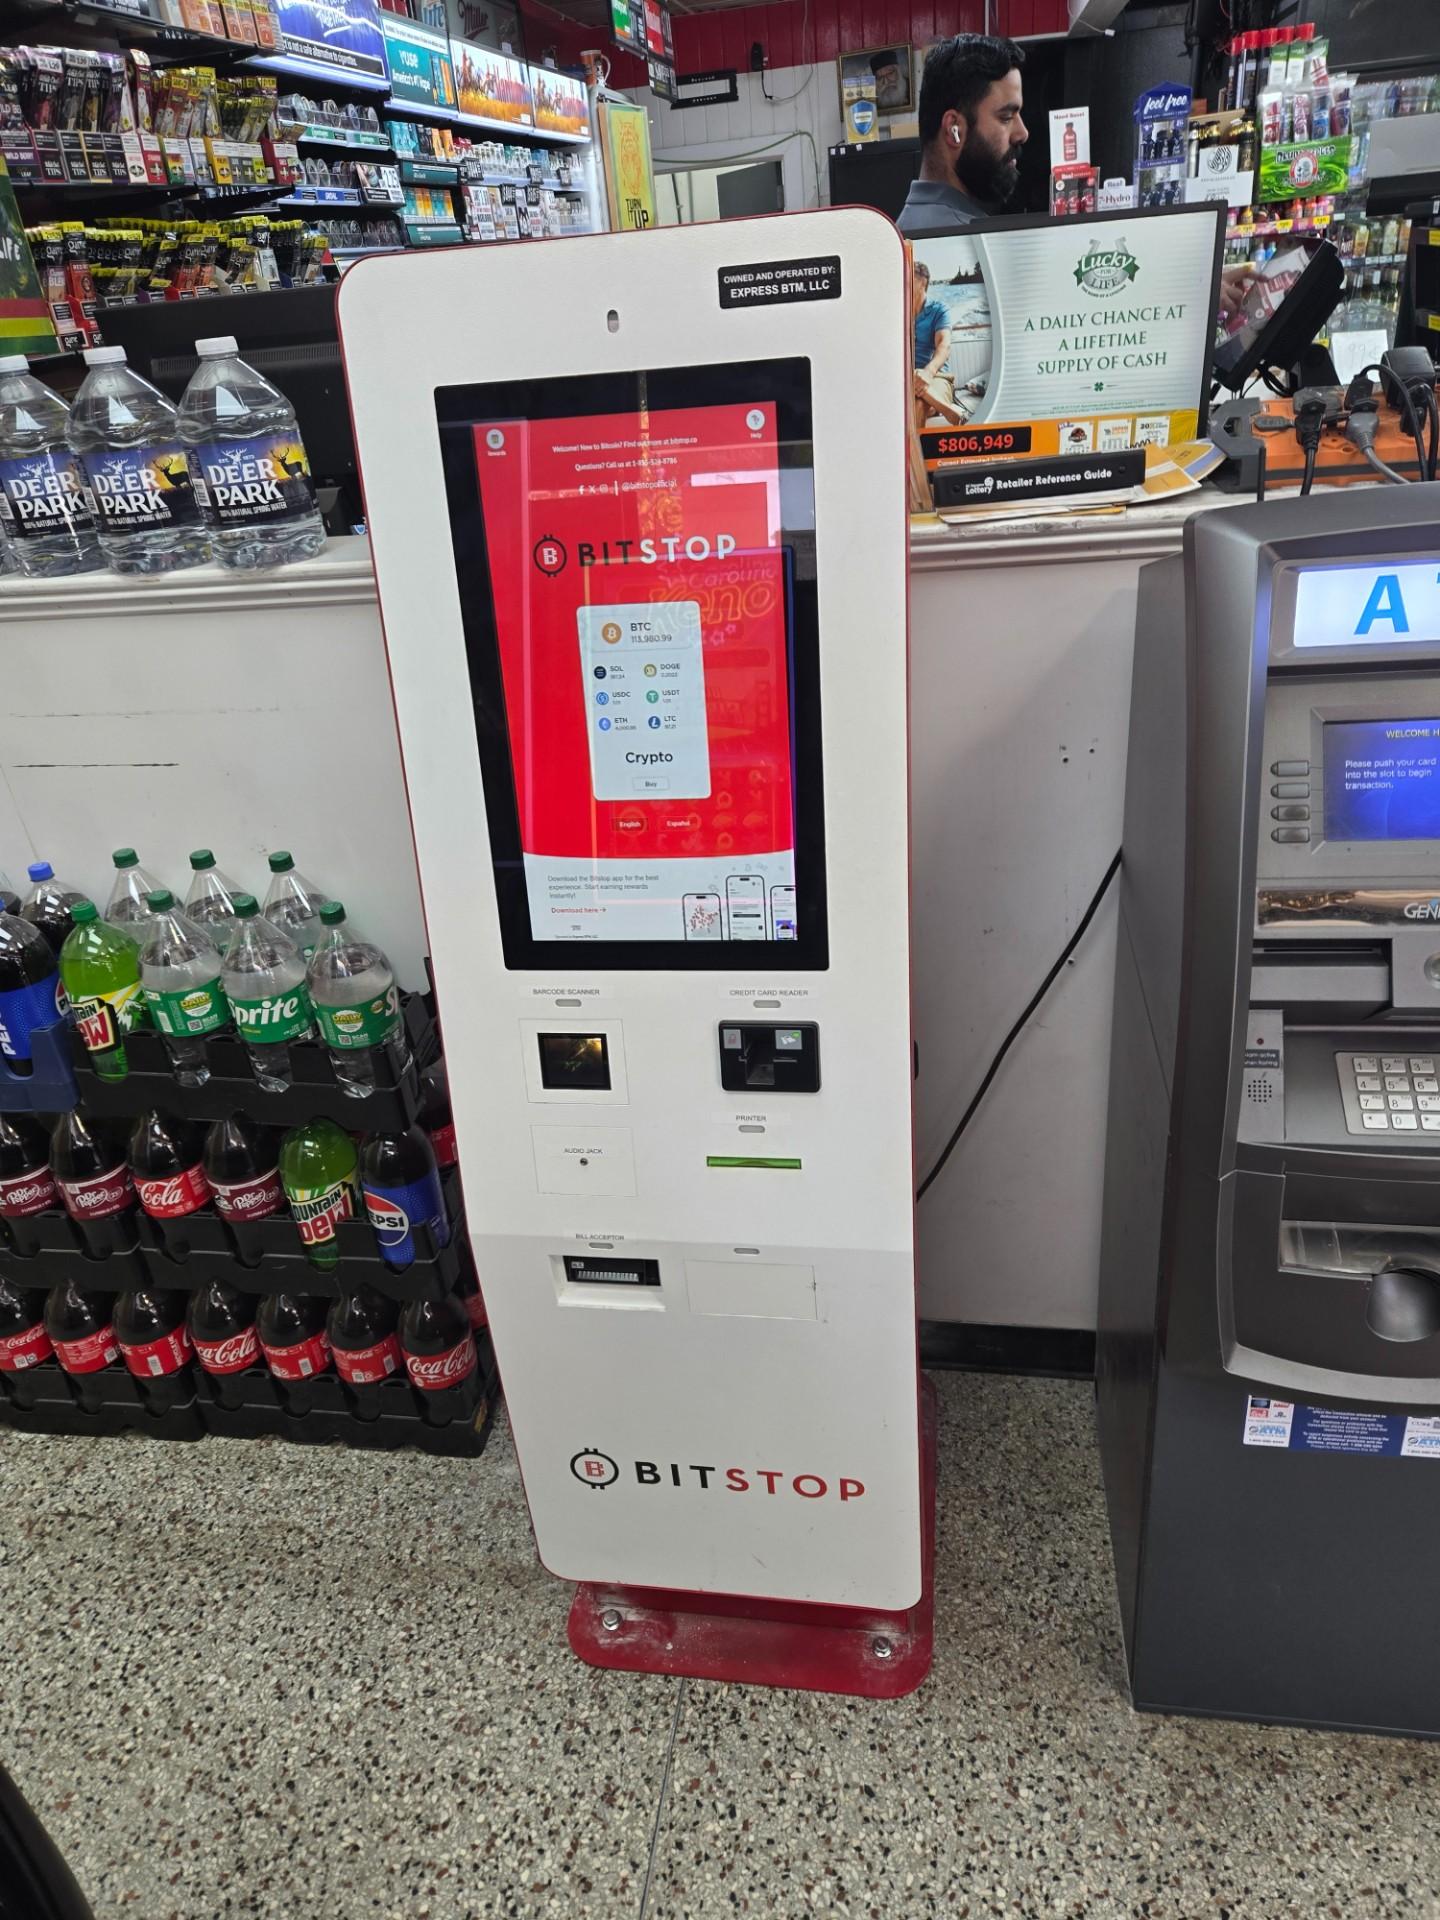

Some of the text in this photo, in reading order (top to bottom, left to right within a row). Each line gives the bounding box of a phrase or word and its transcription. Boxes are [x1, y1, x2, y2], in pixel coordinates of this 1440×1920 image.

[1143, 95, 1166, 115] feel
[1164, 93, 1188, 112] free
[634, 209, 649, 229] UP
[1081, 251, 1133, 273] Lucky
[723, 265, 836, 284] OWNED AND OPERATED BY:
[1091, 275, 1121, 290] LIFE
[730, 279, 831, 299] EXPRESS BTM, LLC
[1024, 304, 1187, 332] A DAILY CHANCE AT
[1058, 331, 1148, 352] A LIFETIME
[1037, 352, 1168, 375] SUPPLY OF CASH
[938, 433, 1014, 454] $806,949
[207, 458, 277, 486] DEER
[574, 462, 606, 472] Questions?
[606, 461, 617, 469] Call
[8, 471, 80, 499] DEER
[93, 468, 161, 494] DEER
[965, 468, 1113, 496] Lottery Retailer Reference Guide
[213, 479, 284, 507] PARK
[15, 490, 87, 519] PARK
[100, 489, 169, 515] PARK
[231, 507, 254, 517] NATURAL
[253, 504, 271, 514] SPRING
[270, 501, 288, 511] WATER
[577, 533, 737, 568] BITSTOP
[630, 622, 652, 632] BTC
[660, 662, 681, 670] DOGE
[1385, 728, 1431, 739] WELCOME
[625, 751, 674, 766] Crypto
[1345, 757, 1437, 769] Please push your card
[1345, 768, 1432, 780] into the slot to begin
[644, 780, 658, 789] Buy
[1345, 781, 1394, 790] transaction.
[619, 820, 641, 829] English
[666, 819, 691, 828] Español
[612, 875, 624, 883] app
[645, 874, 660, 882] best
[1403, 902, 1440, 921] GEN
[532, 988, 600, 996] BARCODE SCANNER
[729, 989, 809, 997] CREDIT CARD READER
[1357, 1062, 1363, 1071] 1
[1384, 1062, 1391, 1071] 2
[1413, 1063, 1421, 1072] 3
[1360, 1081, 1367, 1089] 4
[1388, 1081, 1395, 1090] 5
[1417, 1081, 1425, 1090] 6
[1362, 1098, 1369, 1107] 7
[1391, 1099, 1399, 1108] 8
[1420, 1100, 1428, 1108] 9
[735, 1114, 767, 1122] PRINTER
[1394, 1116, 1402, 1125] 0
[564, 1147, 603, 1155] AUDIO JACK
[634, 1460, 866, 1502] BITSTOP
